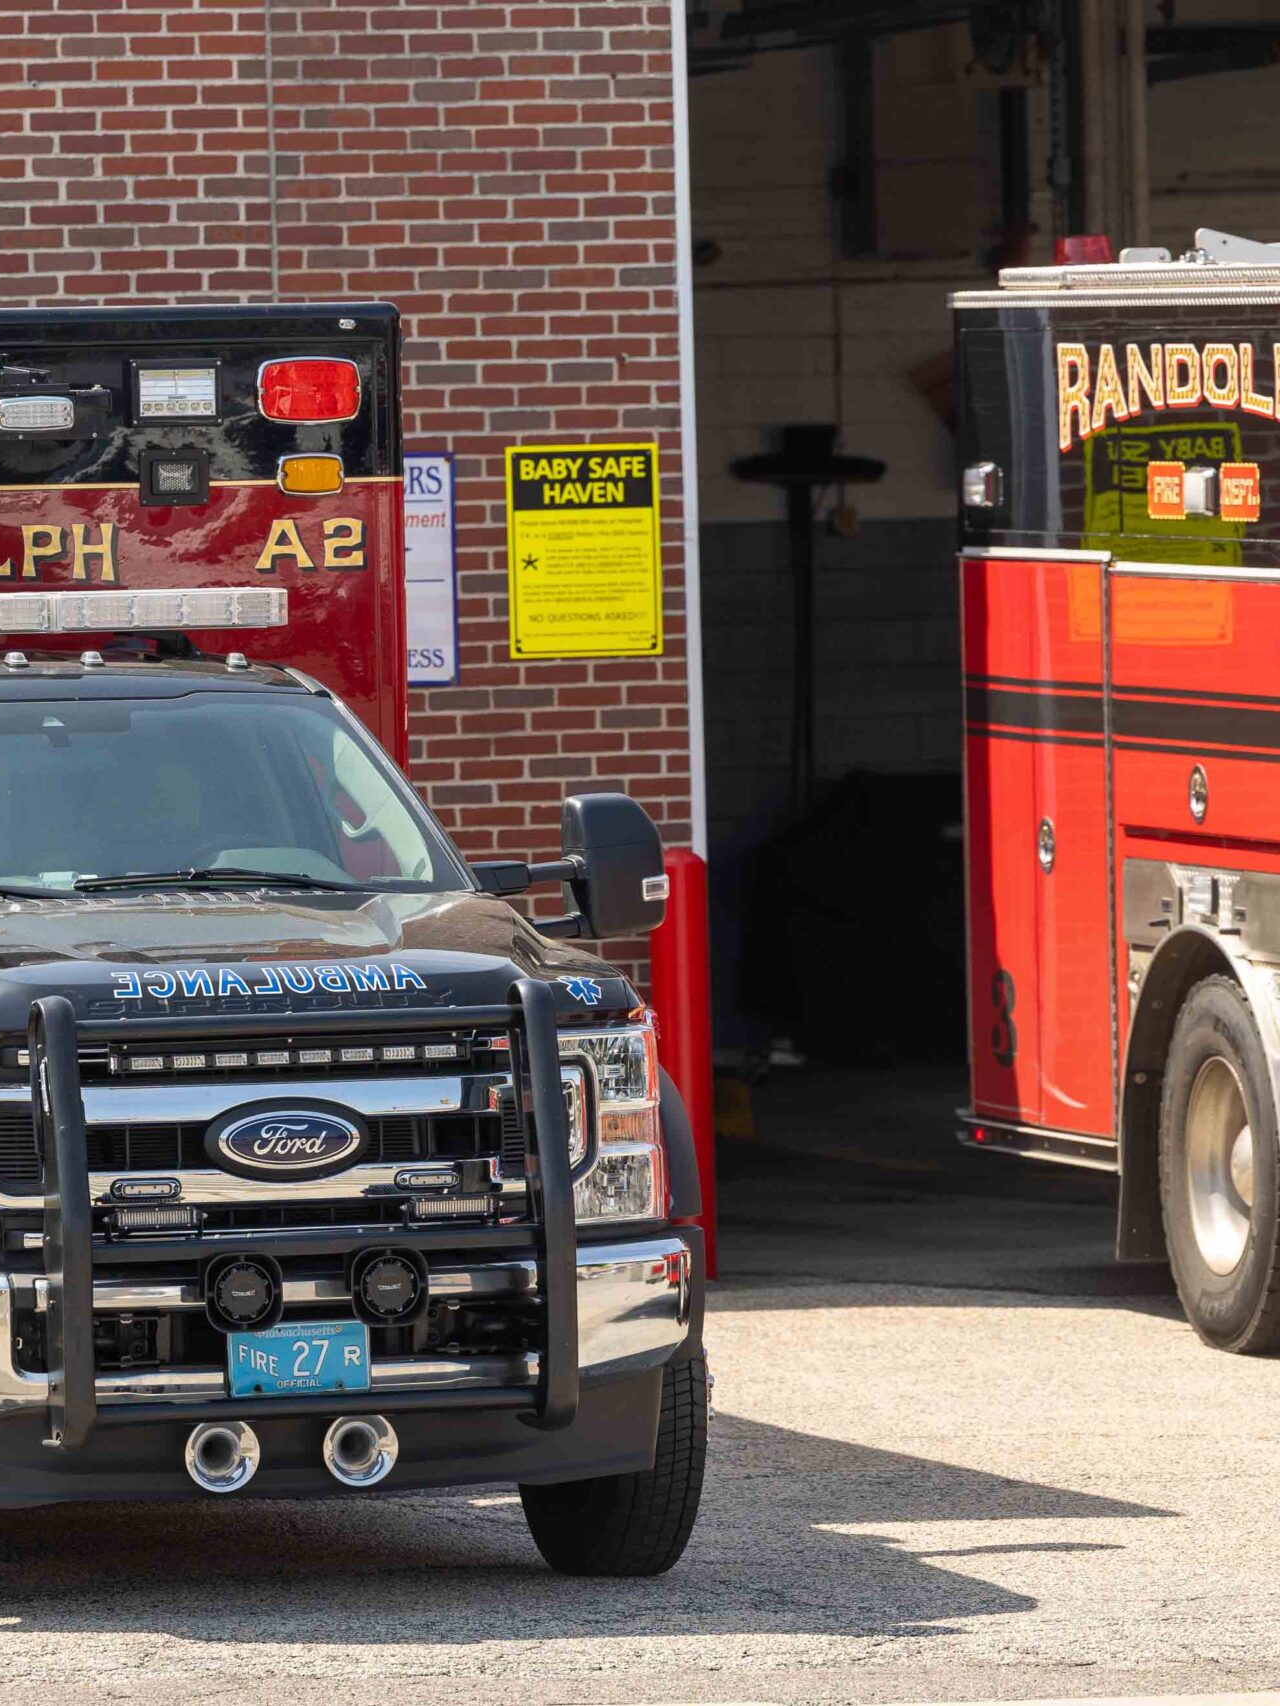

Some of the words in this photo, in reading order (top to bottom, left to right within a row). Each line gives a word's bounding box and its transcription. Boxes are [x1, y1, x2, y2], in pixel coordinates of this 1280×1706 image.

[1057, 343, 1280, 453] RANDOL
[404, 466, 443, 495] RS
[520, 458, 582, 480] BABY
[588, 456, 645, 479] SAFE
[542, 482, 624, 505] HAVEN
[254, 517, 368, 573] A2
[528, 613, 544, 624] NO
[547, 611, 601, 624] QUESTIONS
[991, 968, 1018, 1068] 3
[253, 1123, 326, 1155] Ford
[238, 1344, 279, 1377] FIRE
[292, 1339, 329, 1377] 27
[344, 1345, 361, 1367] R
[277, 1378, 322, 1389] OFFICIAL
